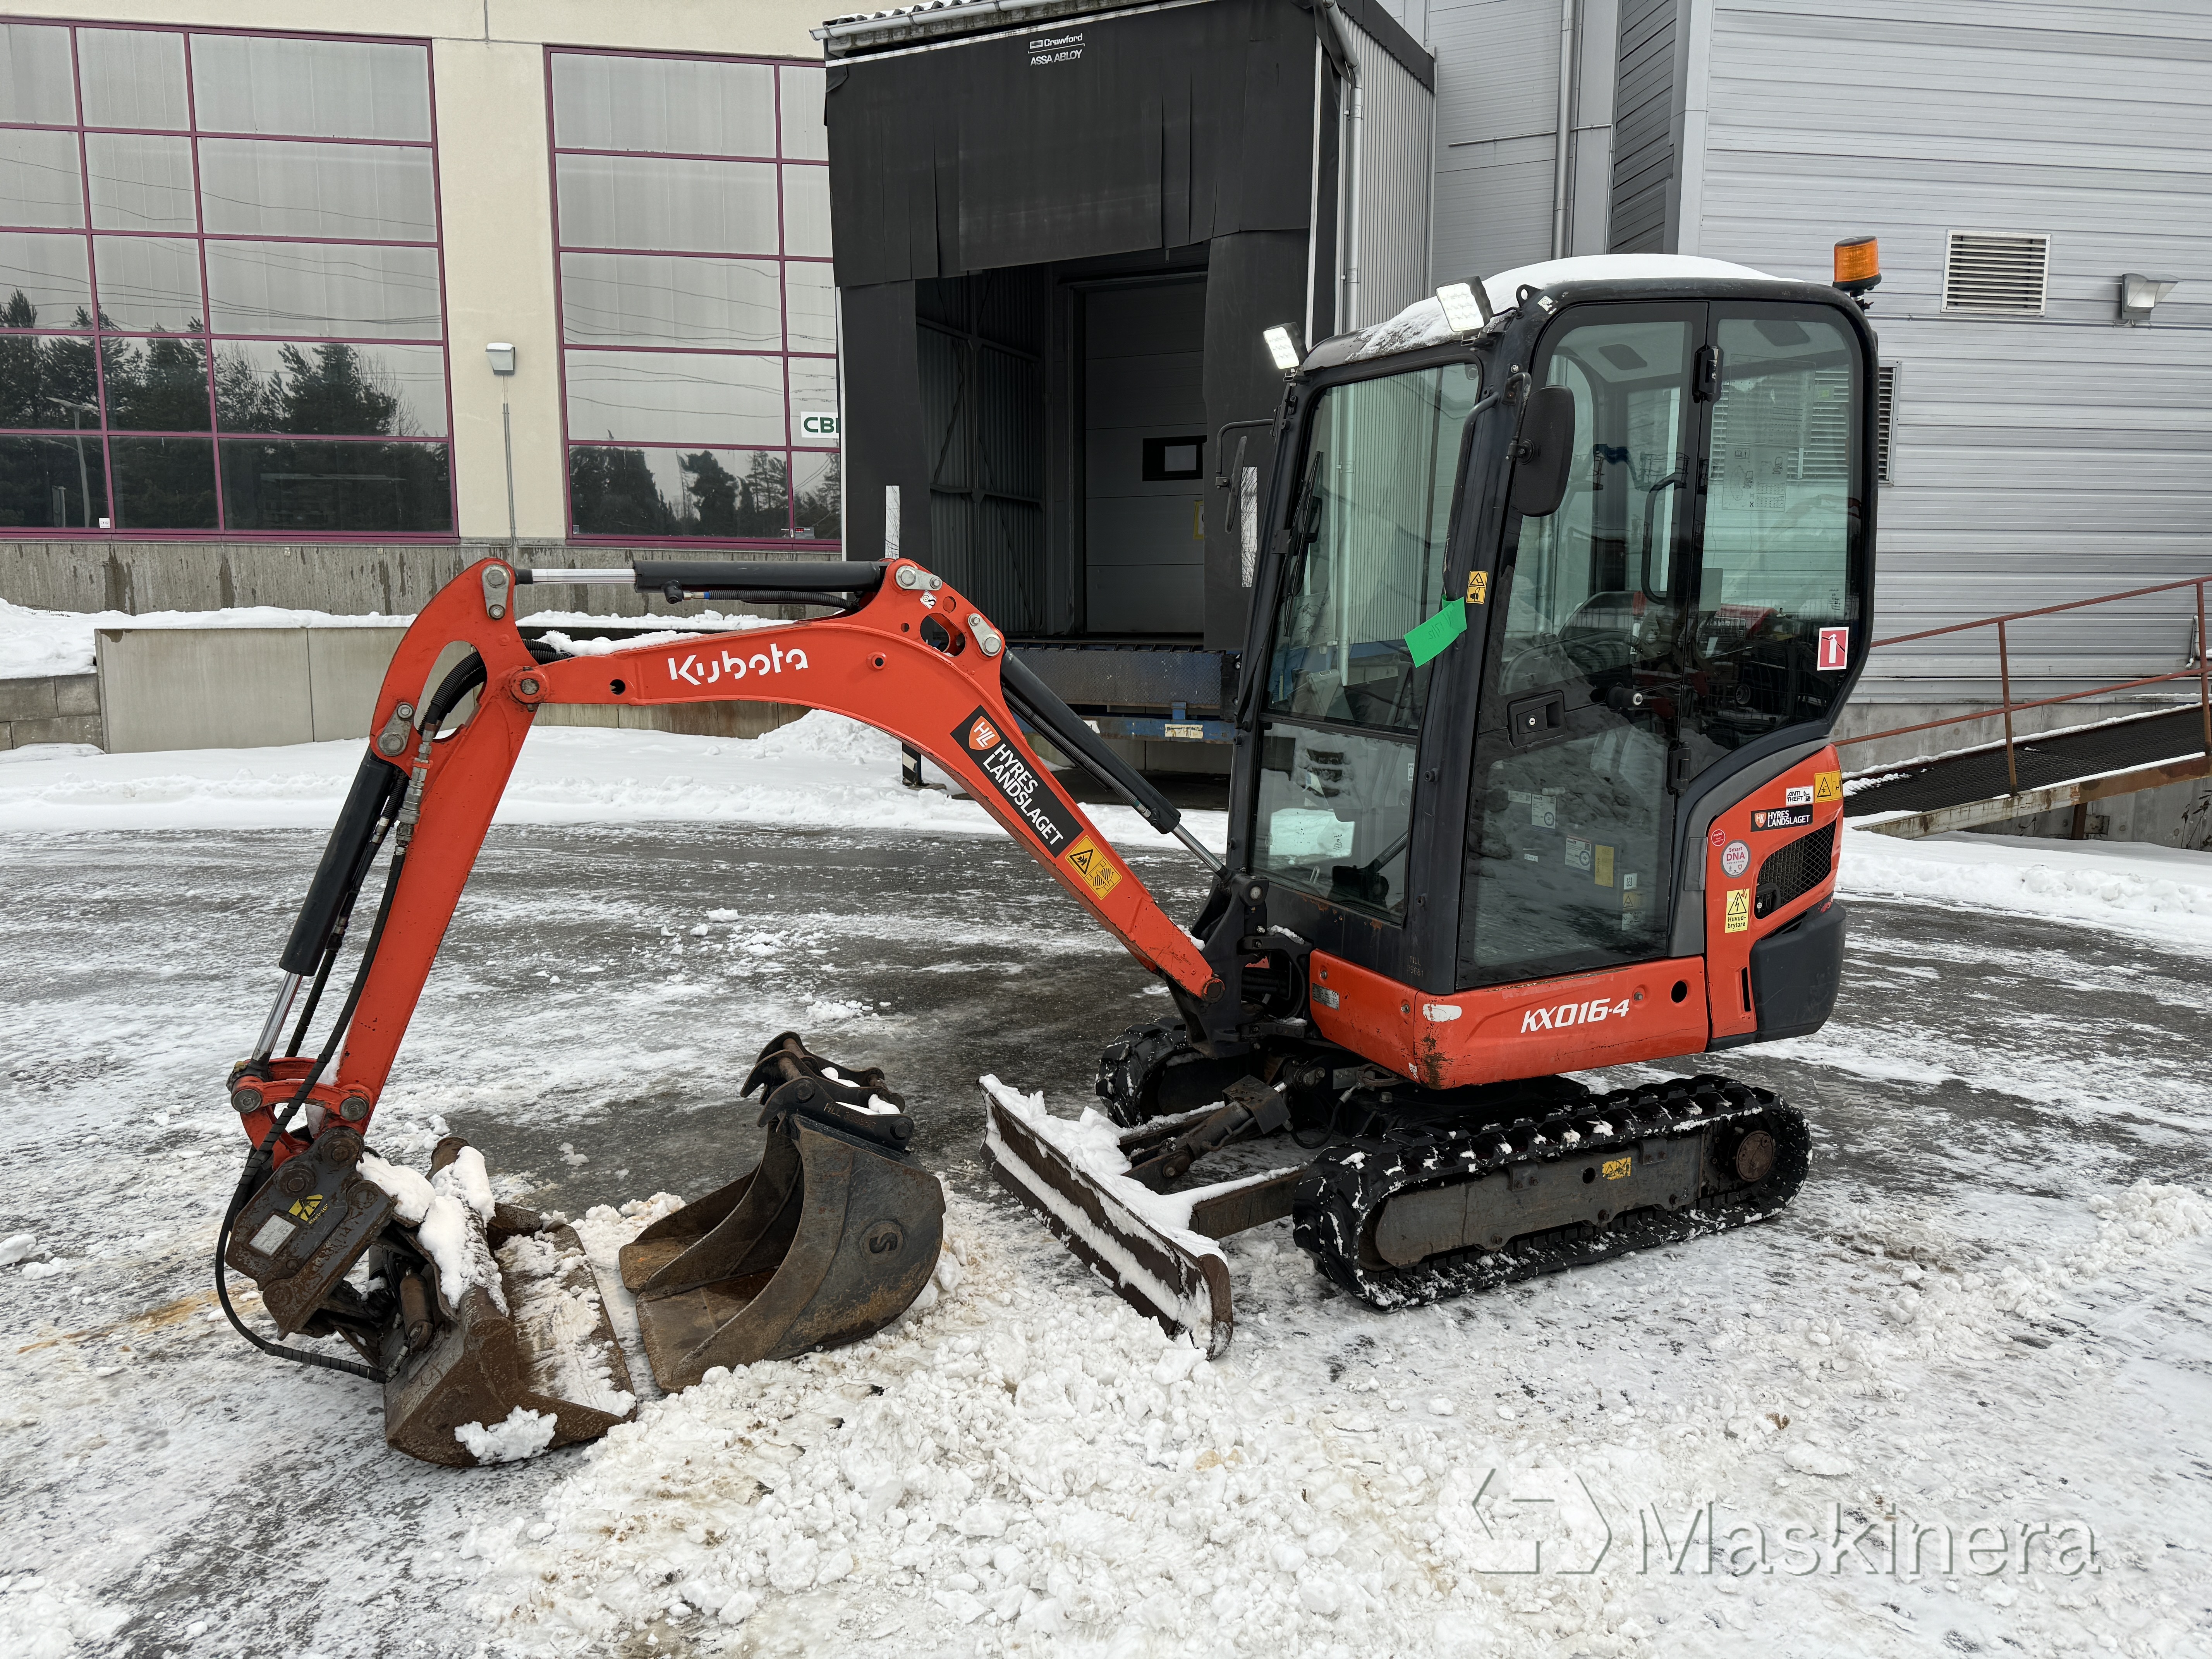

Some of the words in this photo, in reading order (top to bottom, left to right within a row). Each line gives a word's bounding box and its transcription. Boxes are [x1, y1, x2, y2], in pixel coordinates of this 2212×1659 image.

[1044, 33, 1083, 47] Crawford
[1030, 55, 1053, 66] ASSA
[1054, 49, 1083, 63] ABLOY
[668, 643, 809, 685] Kubota
[994, 743, 1038, 793] HYRES
[983, 754, 1064, 845] LANDSLAGET
[1767, 810, 1789, 819] HYRES
[1767, 815, 1810, 828] LANDSLAGET
[1726, 852, 1745, 862] DNA
[1520, 998, 1630, 1034] KX016-4
